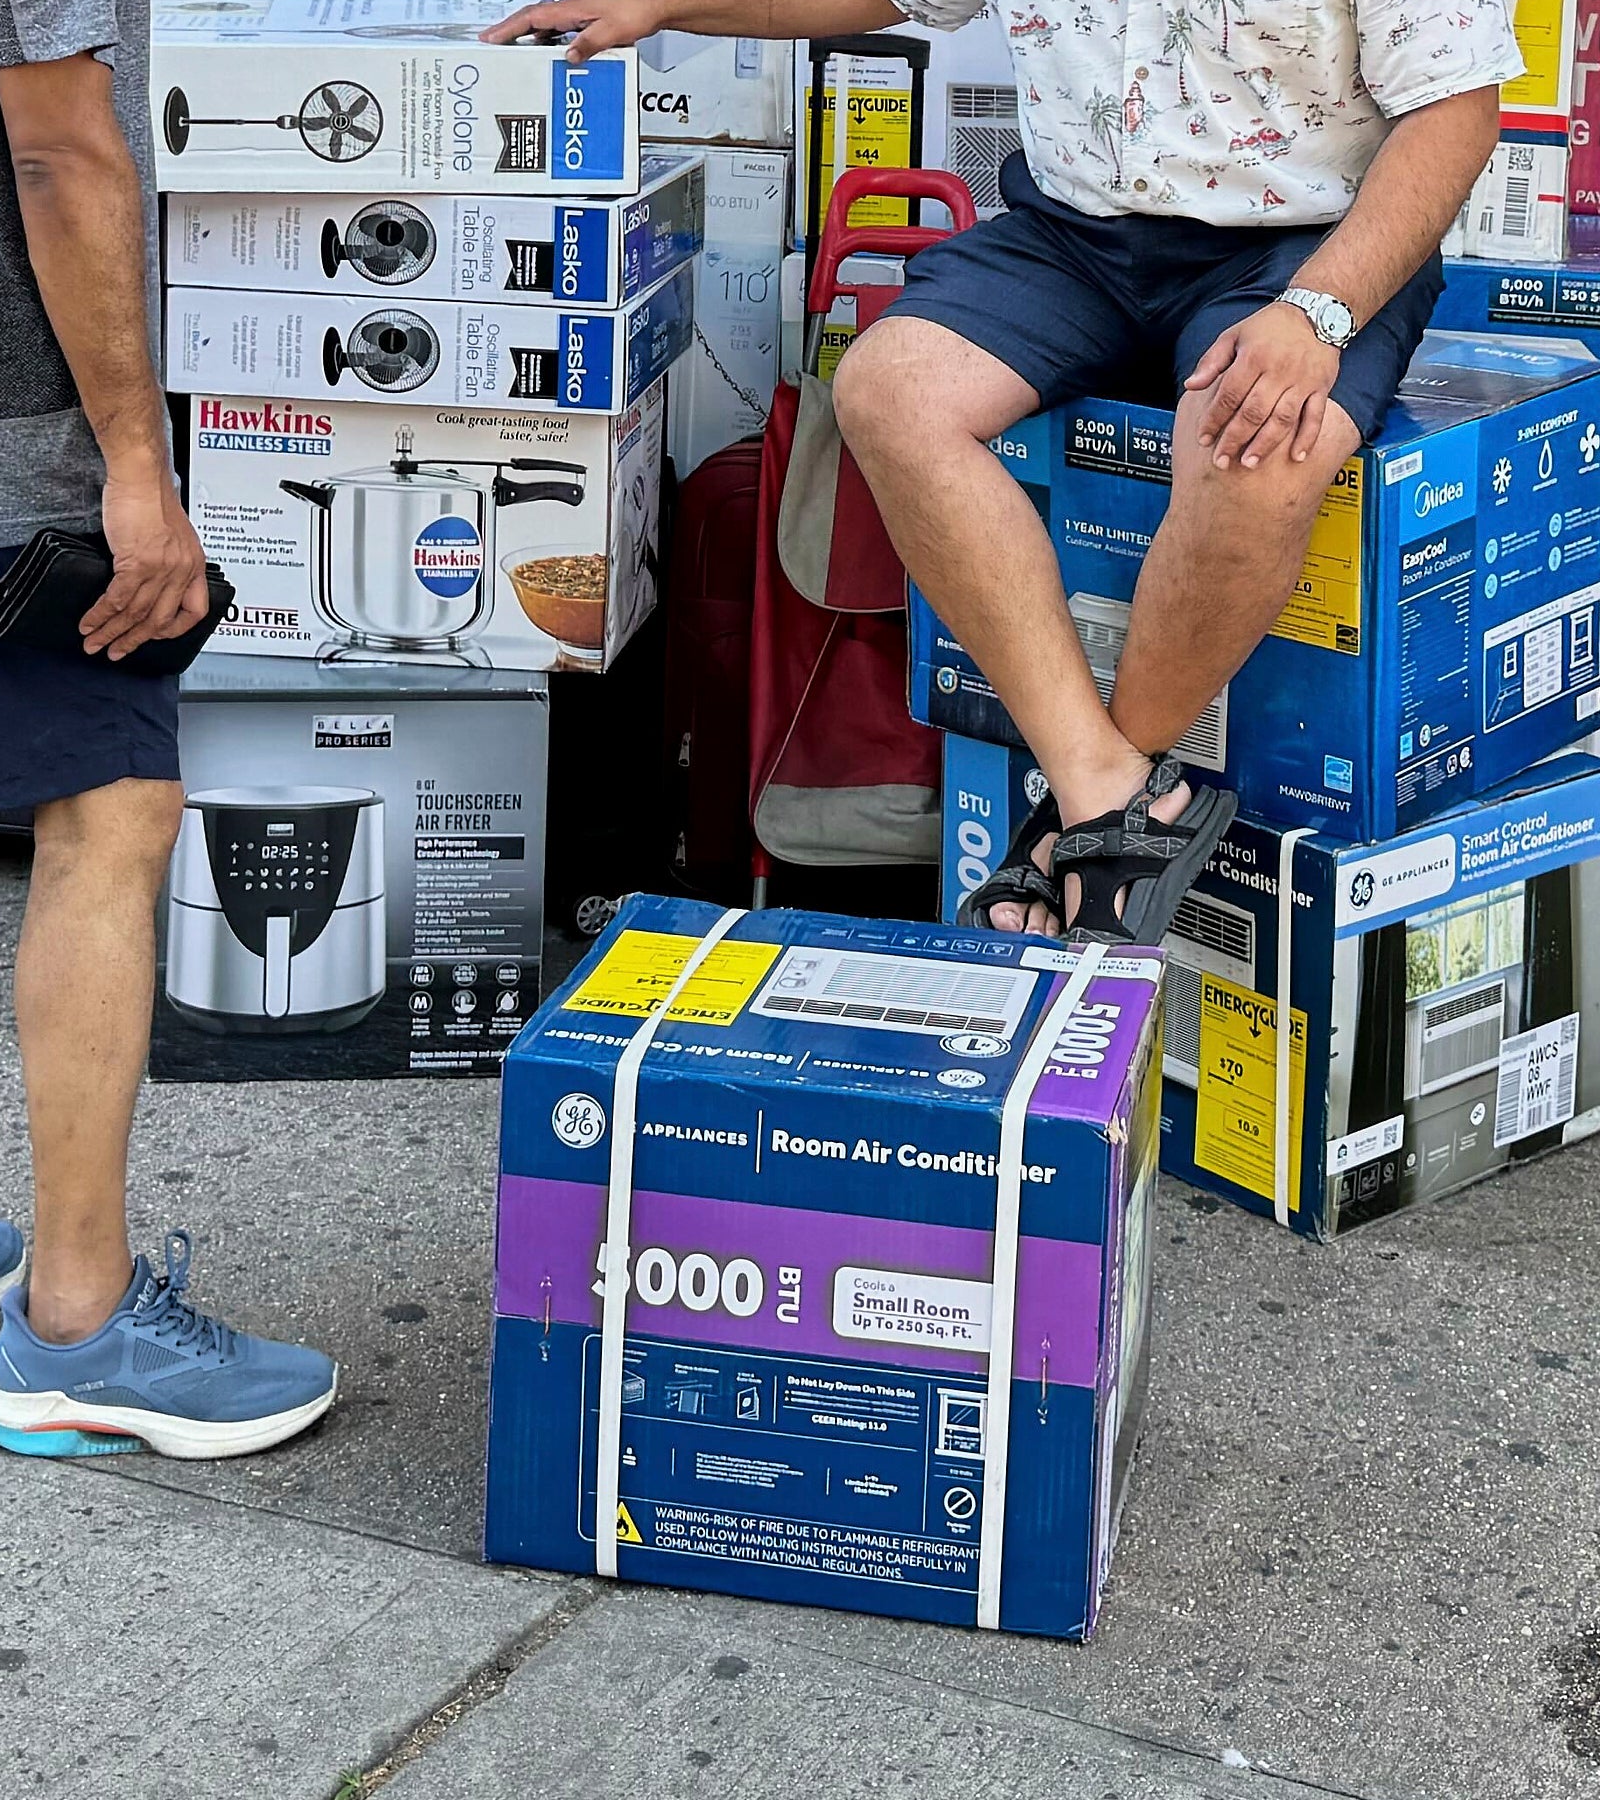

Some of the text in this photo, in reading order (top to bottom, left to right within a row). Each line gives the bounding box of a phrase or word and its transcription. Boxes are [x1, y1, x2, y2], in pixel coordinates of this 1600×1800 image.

[447, 63, 480, 174] Cyclone
[564, 67, 589, 171] Lasko
[855, 149, 879, 160] $44
[462, 206, 480, 291] Table Fan
[478, 215, 496, 283] Oscillating
[561, 208, 585, 296] Lasko
[719, 270, 769, 304] 110
[1501, 277, 1544, 292] 8,000
[566, 316, 589, 405] Lasko
[200, 399, 333, 436] Hawkins
[436, 411, 569, 431] Cook great-tasting food
[1075, 418, 1115, 436] 8,000
[199, 433, 331, 455] STAINLESS STEEL
[499, 428, 569, 444] faster, safer!
[1074, 435, 1116, 455] BTU/h
[1132, 436, 1158, 452] 350
[1414, 480, 1464, 518] Midea
[1072, 519, 1104, 538] YEAR
[413, 547, 482, 568] Hawkins
[1402, 537, 1447, 571] EasyCool
[242, 610, 299, 626] LITRE
[260, 629, 312, 642] COOKER
[316, 719, 390, 731] BELLA
[316, 734, 390, 747] PRO SERIES
[416, 793, 522, 811] TOUCHSCREEN
[957, 790, 992, 818] BTU
[415, 814, 491, 831] AIR FRYER
[1461, 811, 1548, 853] Smart Control
[261, 845, 299, 860] 02:25
[1460, 816, 1596, 871] Room Air Conditioner
[1396, 857, 1450, 883] APPLIANCES
[1527, 1041, 1559, 1067] AWCS
[1526, 1078, 1552, 1101] WWF
[642, 1121, 1057, 1185] APPLIANCES Room Air Conditiner
[776, 1266, 802, 1324] BTU
[852, 1289, 971, 1321] Small Room
[896, 1317, 973, 1340] 250 Sq. Ft.
[655, 1506, 980, 1561] WARNING-RISK OF FIRE DUE TO FLAMMABLE REFRIGERANT
[655, 1521, 967, 1573] USED. FOLLOW HANDLING INSTRUCTIONS CAREFULLY IN
[655, 1535, 904, 1580] COMPLIANCE WITH NATIONAL REGULATIONS.
